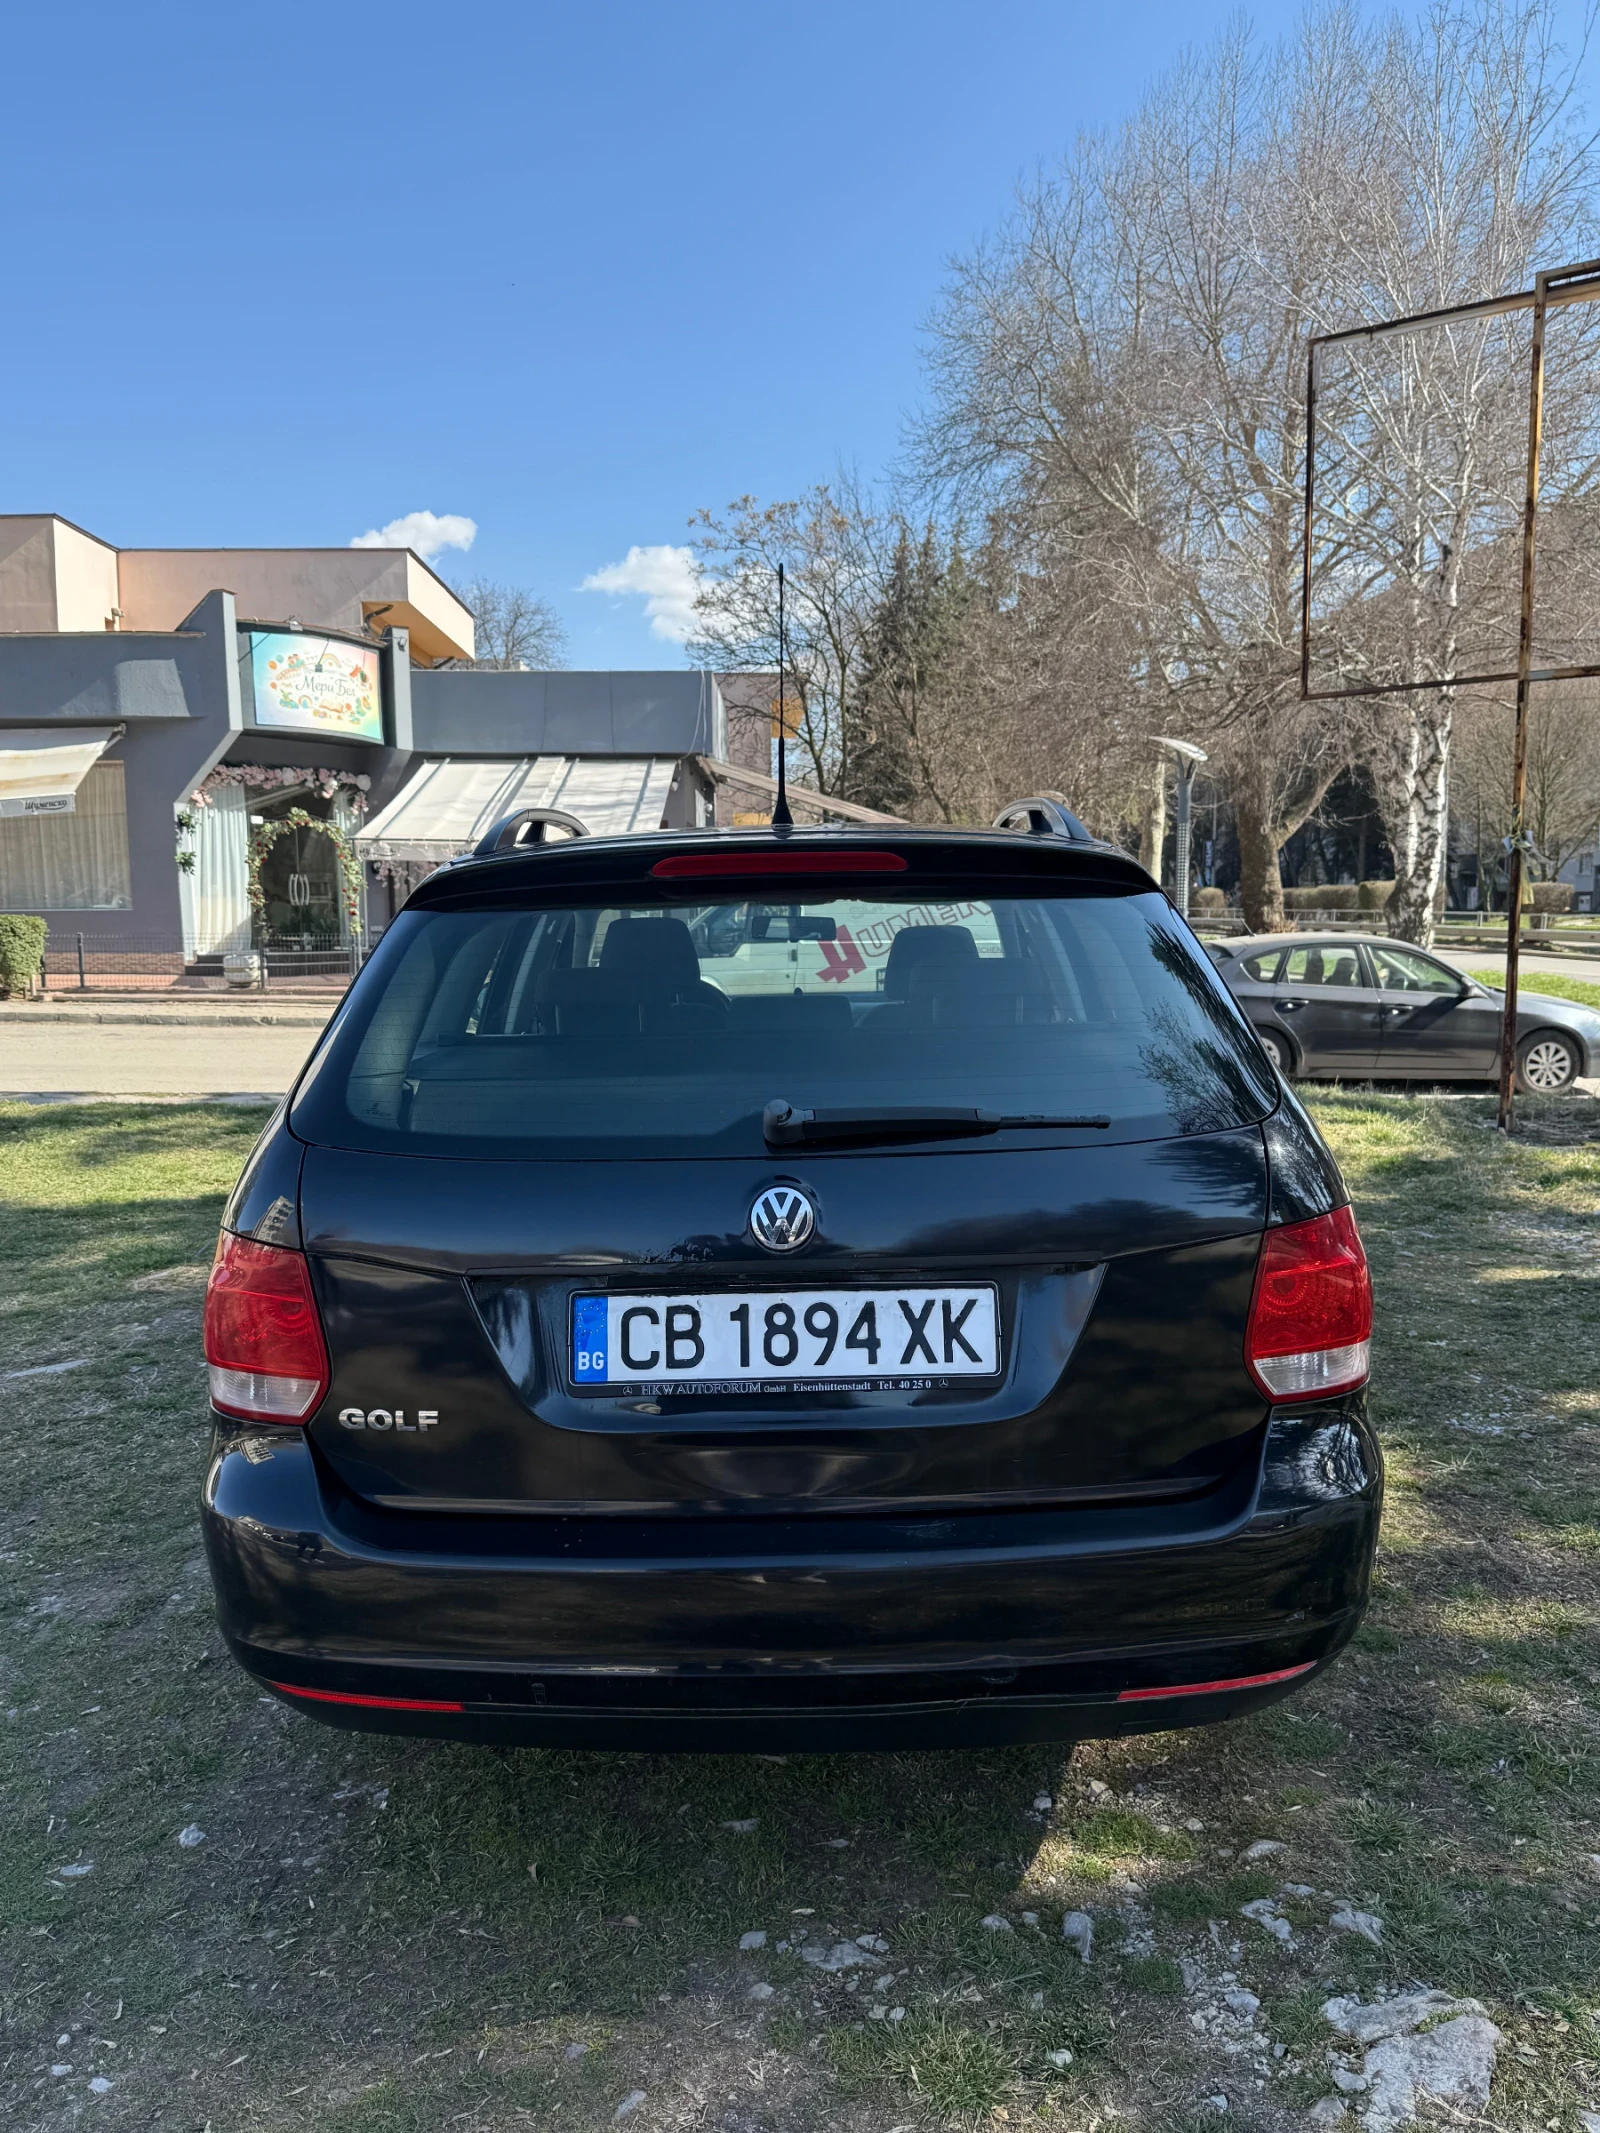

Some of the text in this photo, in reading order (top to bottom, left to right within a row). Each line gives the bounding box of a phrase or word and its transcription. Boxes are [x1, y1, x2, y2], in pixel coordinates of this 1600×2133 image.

[295, 675, 334, 697] Мери
[620, 1297, 984, 1371] CB 1894 XK
[577, 1351, 605, 1371] BG
[641, 1384, 674, 1396] HKW
[676, 1382, 761, 1395] AUTOFORUM
[764, 1385, 787, 1393] GmbH
[793, 1381, 871, 1392] Eisenhüttenstadt
[877, 1380, 895, 1390] Tel.
[338, 1407, 440, 1433] GOLF
